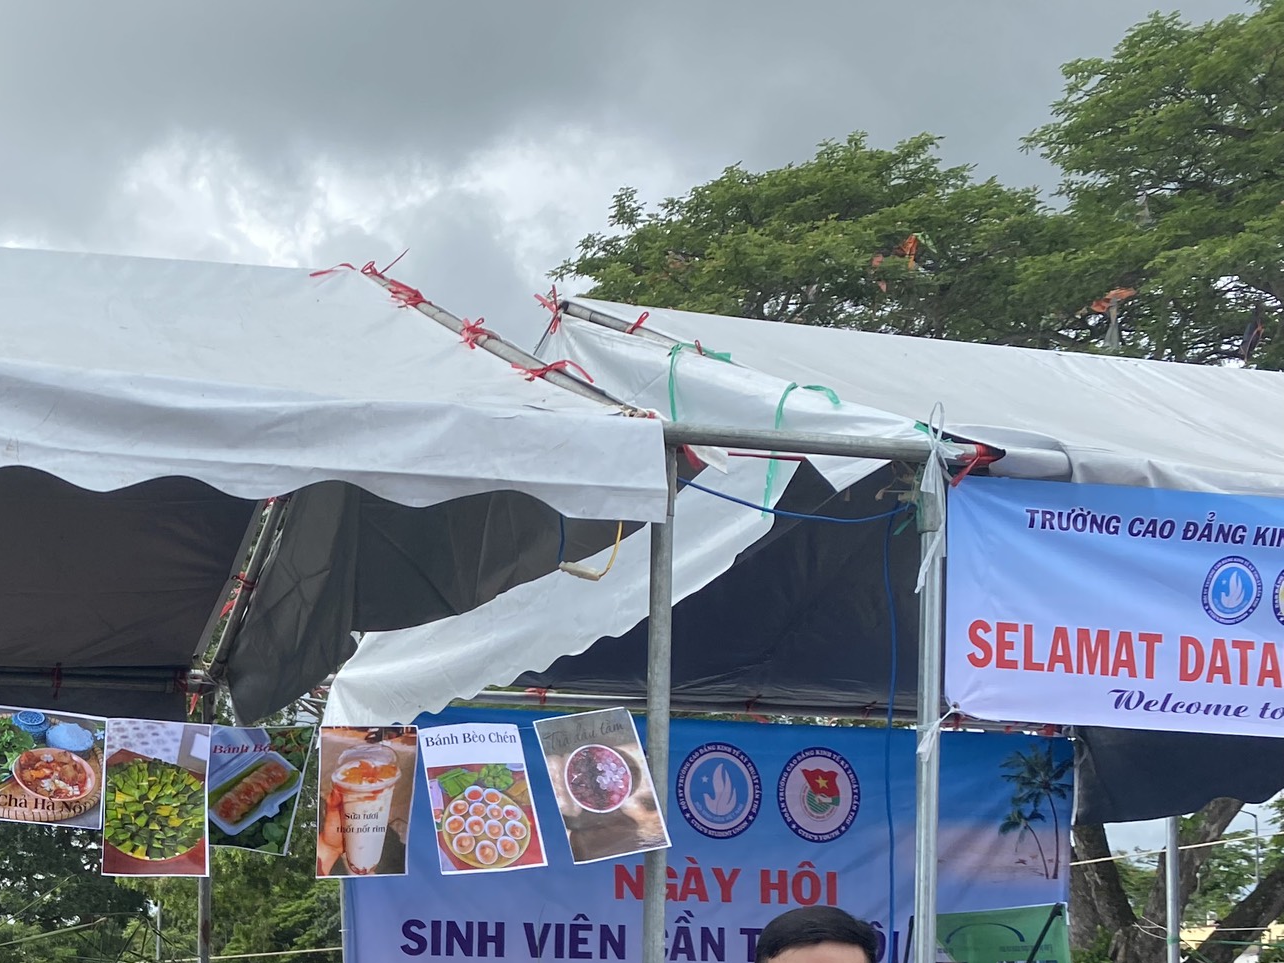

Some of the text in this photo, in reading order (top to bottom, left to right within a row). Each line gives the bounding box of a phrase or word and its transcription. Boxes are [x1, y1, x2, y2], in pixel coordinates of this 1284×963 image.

[1025, 506, 1121, 536] TRƯỜNG
[1127, 516, 1175, 539] CAO
[1181, 511, 1247, 546] ĐẲNG
[966, 618, 1163, 680] SELAMAT
[1107, 687, 1284, 720] Welcome to
[213, 743, 249, 754] Bánh
[424, 730, 517, 747] Bánh Bèo Chén
[33, 796, 56, 811] Hà
[400, 918, 506, 958] SINH
[523, 913, 626, 960] VIÊN
[665, 909, 726, 962] ẦN
